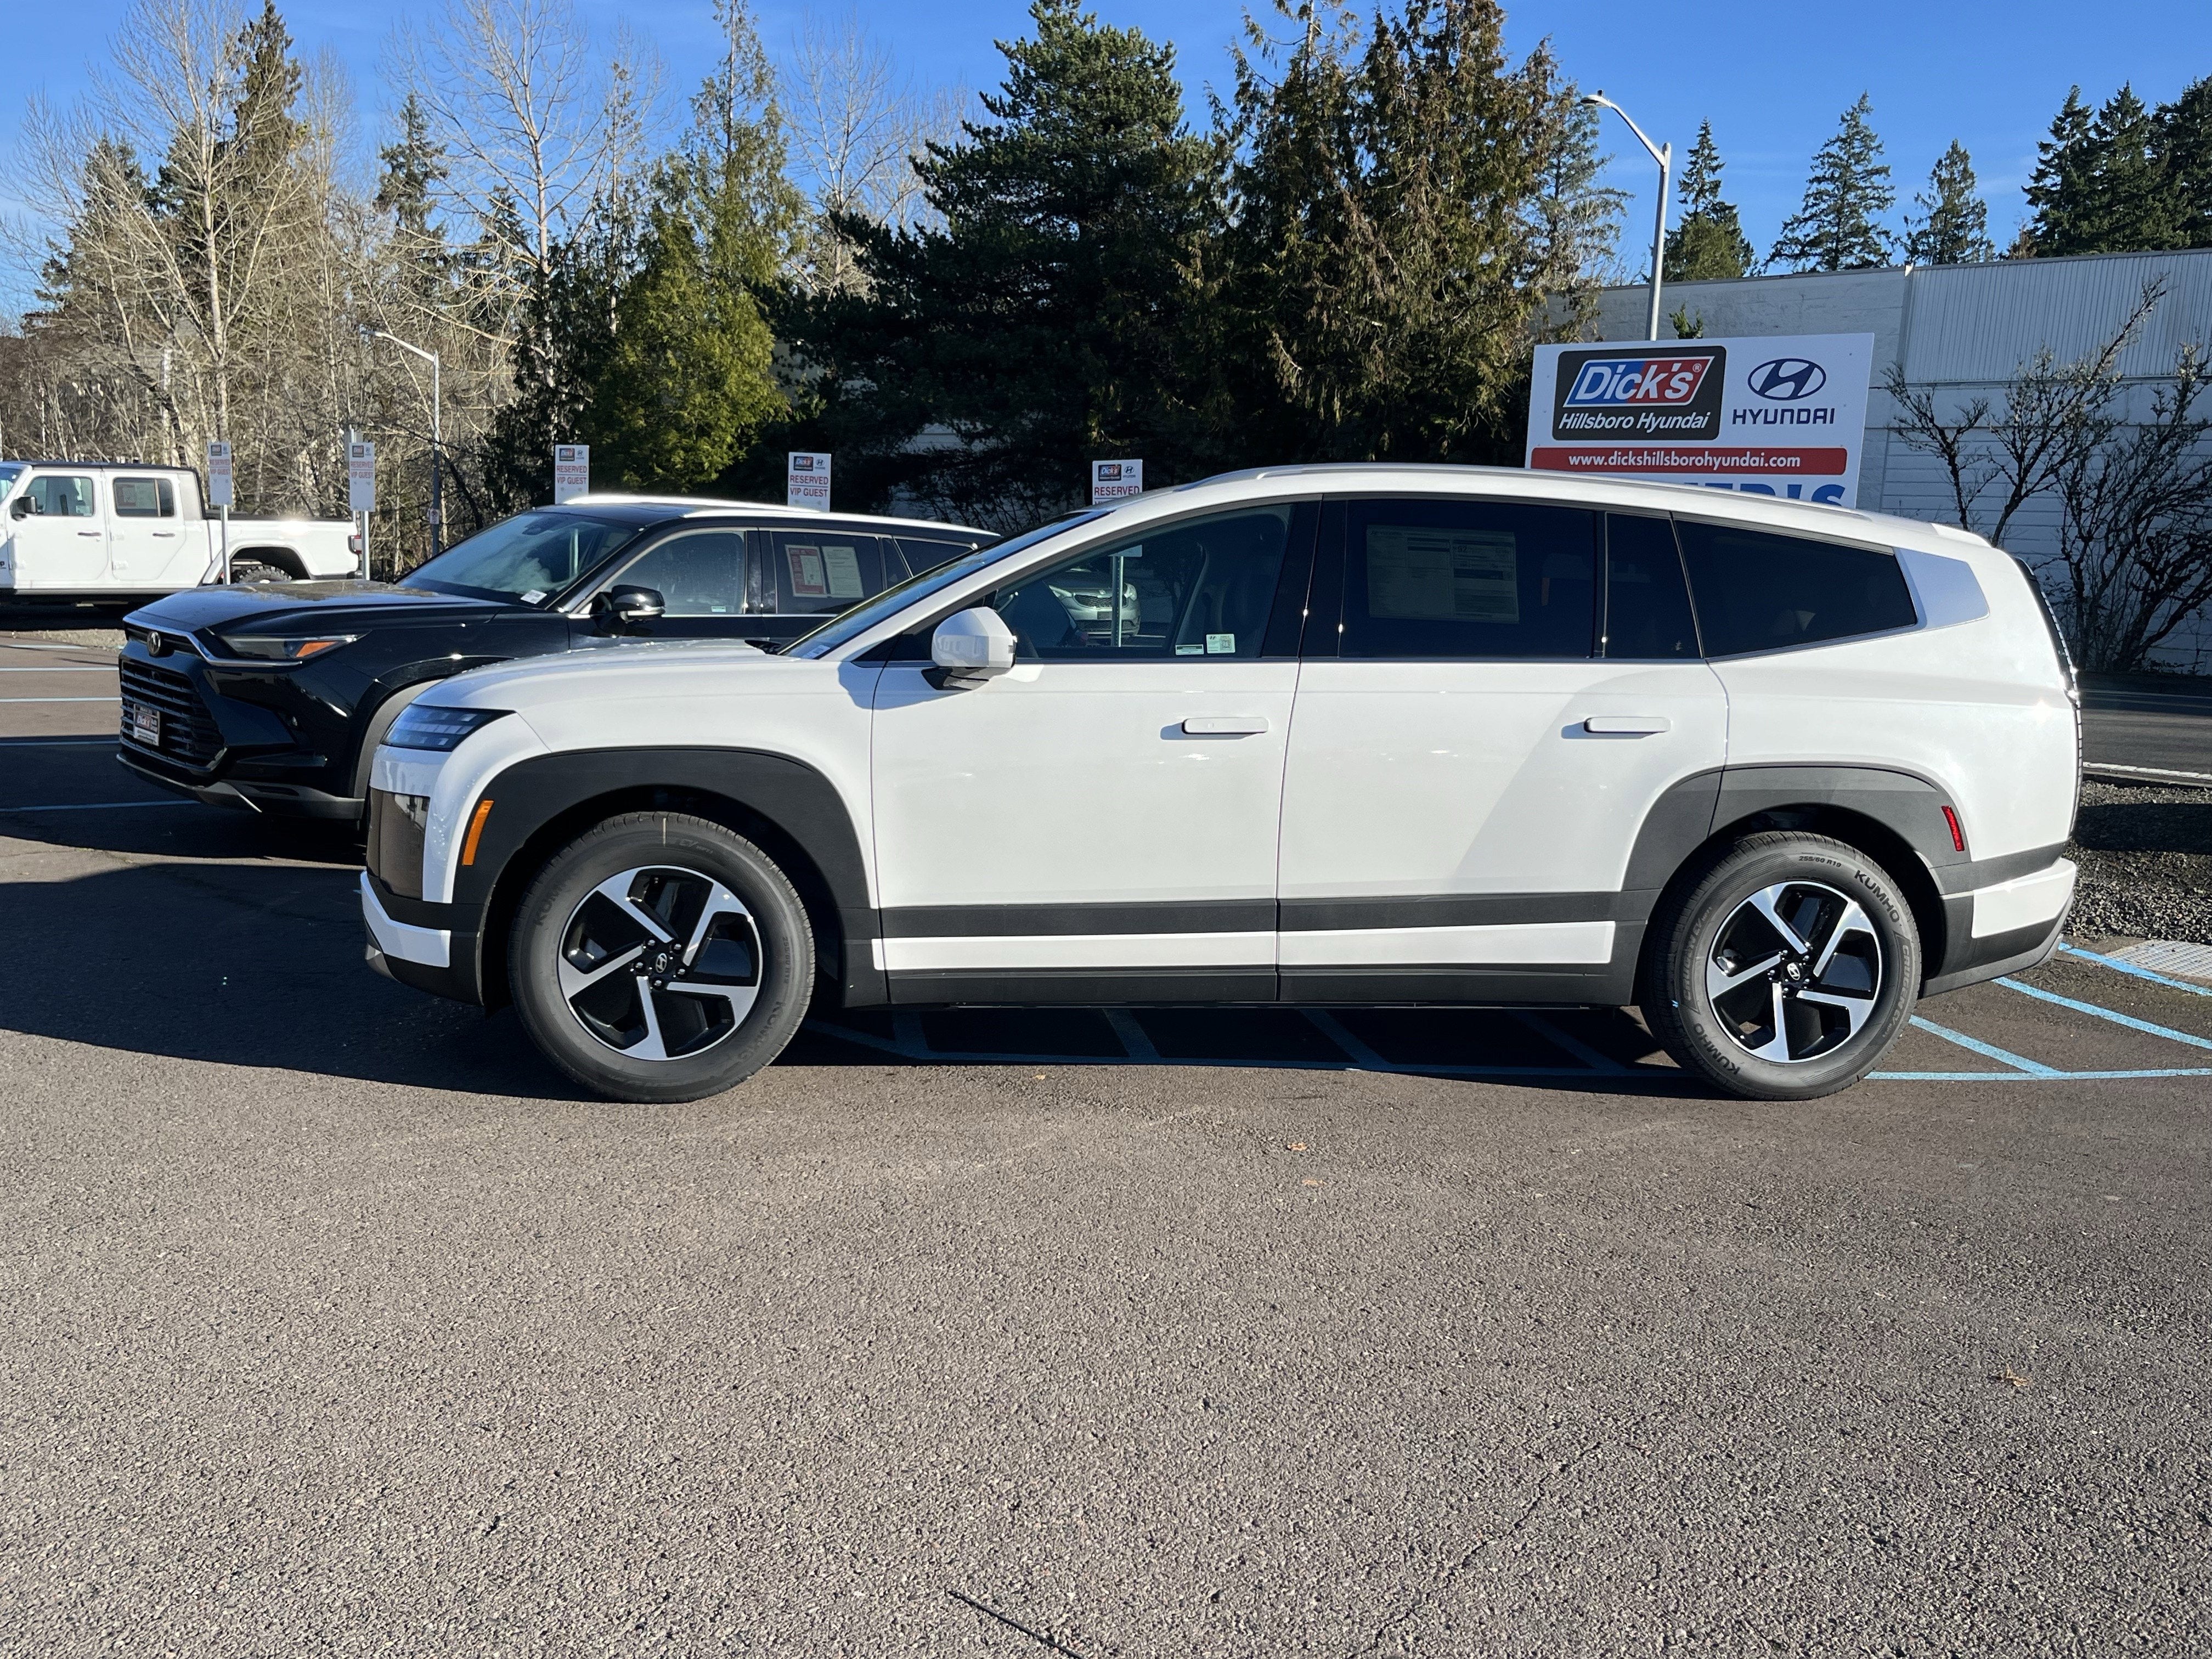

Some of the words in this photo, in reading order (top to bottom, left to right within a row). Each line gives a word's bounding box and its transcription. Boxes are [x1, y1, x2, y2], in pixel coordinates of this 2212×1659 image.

[1575, 363, 1694, 399] Dick's
[1558, 413, 1634, 430] Hillsboro
[1636, 411, 1711, 433] Hyundai
[1732, 408, 1835, 425] HYUNDAI
[1568, 451, 1801, 470] www.dickshillsborohyundai.com
[790, 475, 828, 484] RESERVED
[790, 487, 801, 495] VIP
[803, 488, 827, 497] GUEST
[1094, 486, 1139, 496] RESERVED
[1798, 855, 1825, 864] 255/60
[1826, 859, 1842, 868] R19
[1854, 870, 1900, 923] KUMHO
[1898, 944, 1910, 1009] CRUGEN
[1694, 1023, 1740, 1075] KUMHO
